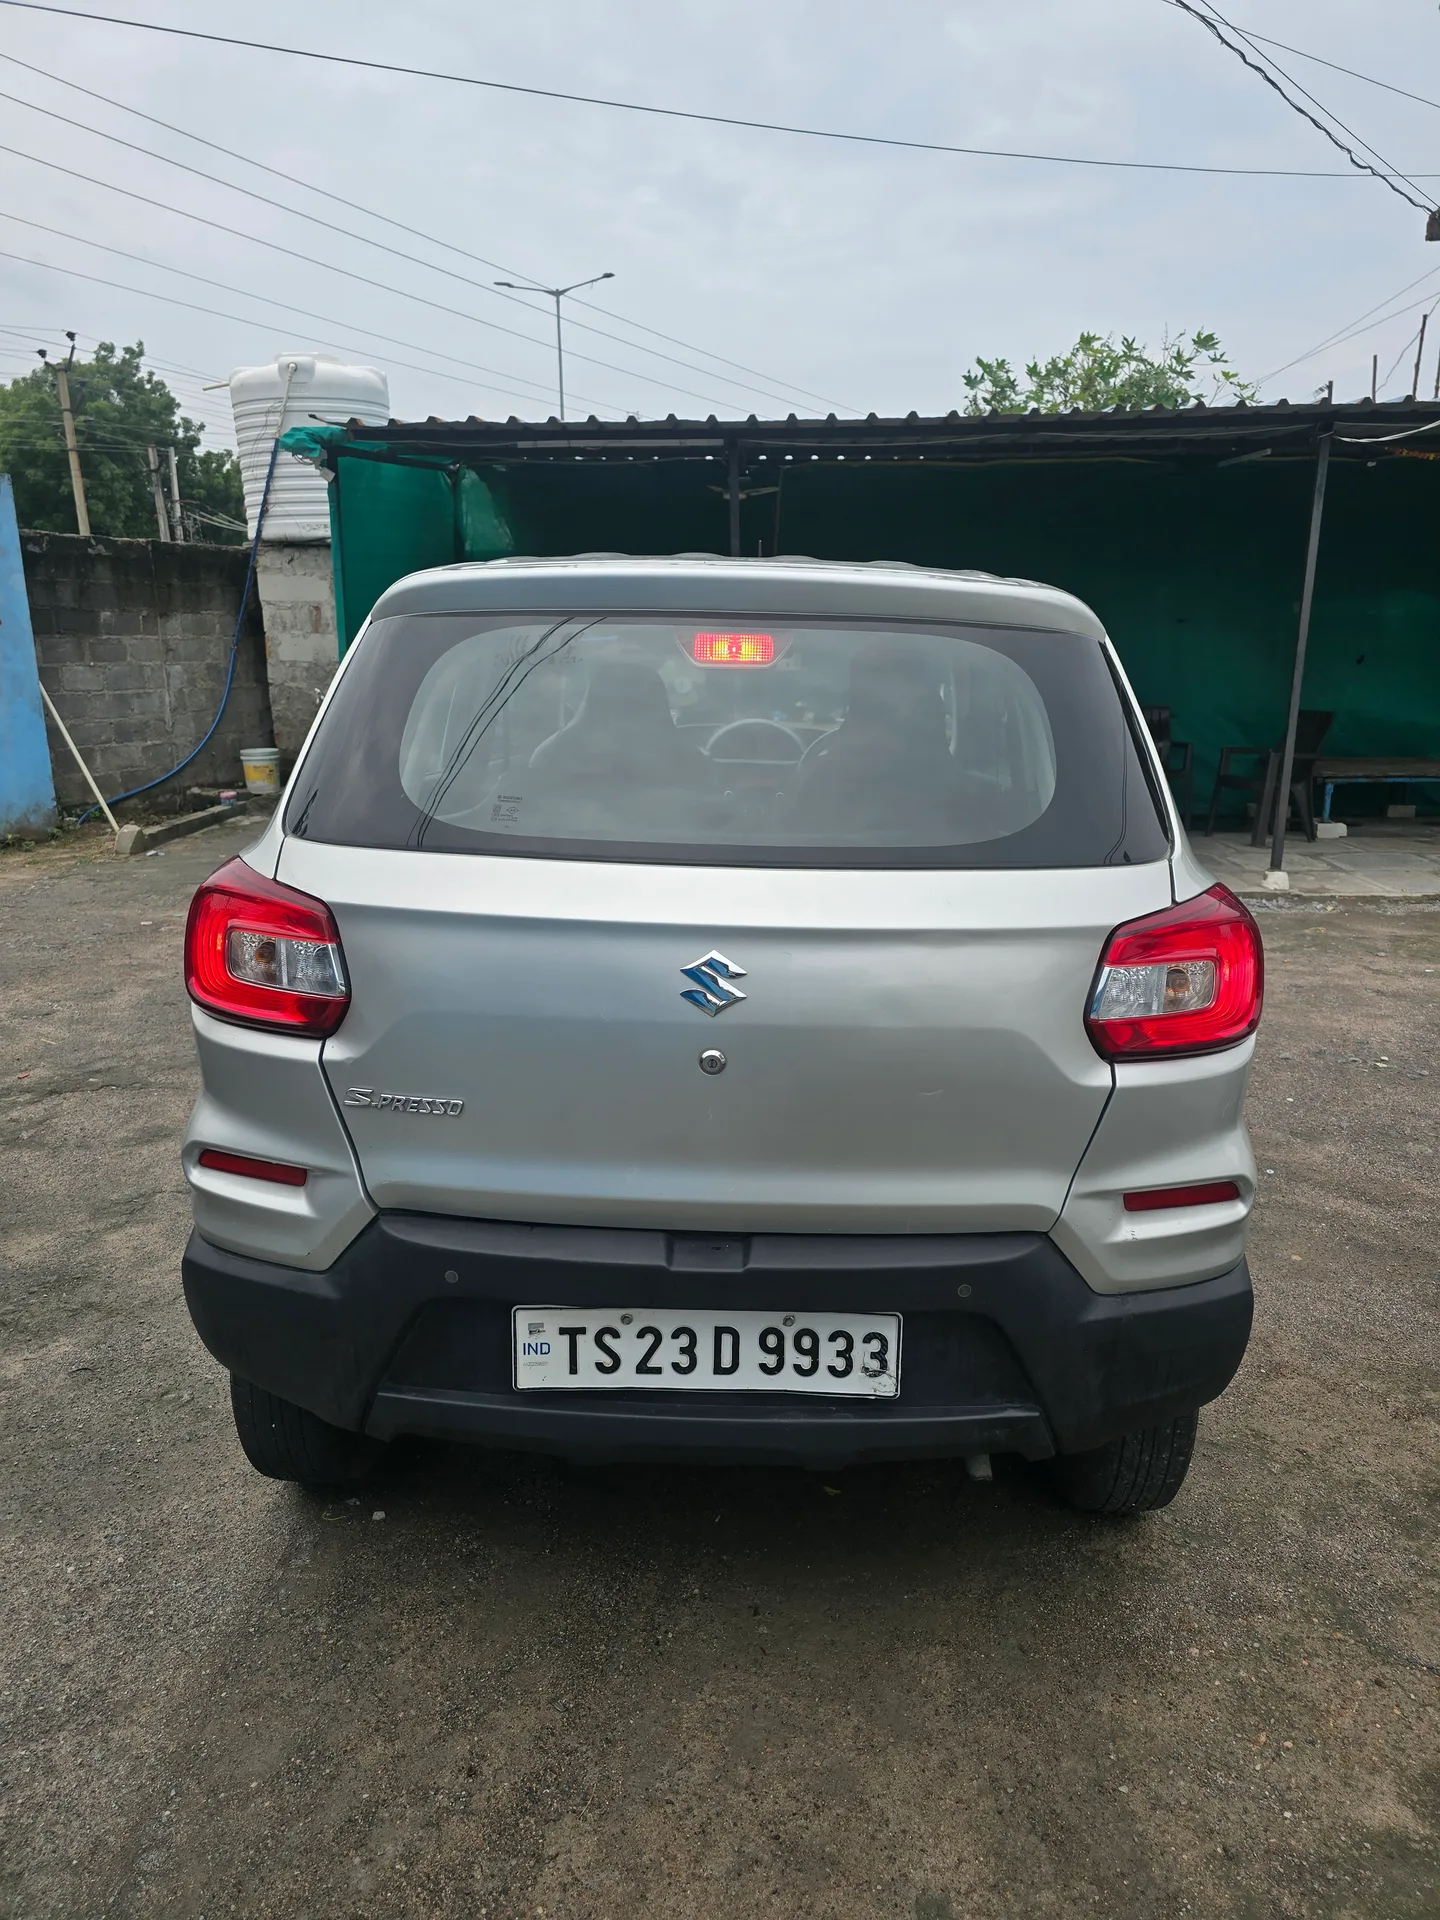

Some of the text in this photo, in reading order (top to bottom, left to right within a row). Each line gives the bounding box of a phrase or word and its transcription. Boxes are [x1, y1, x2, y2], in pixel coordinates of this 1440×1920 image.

[522, 1342, 551, 1356] IND
[712, 1326, 741, 1376] D
[757, 1326, 890, 1379] 9933
